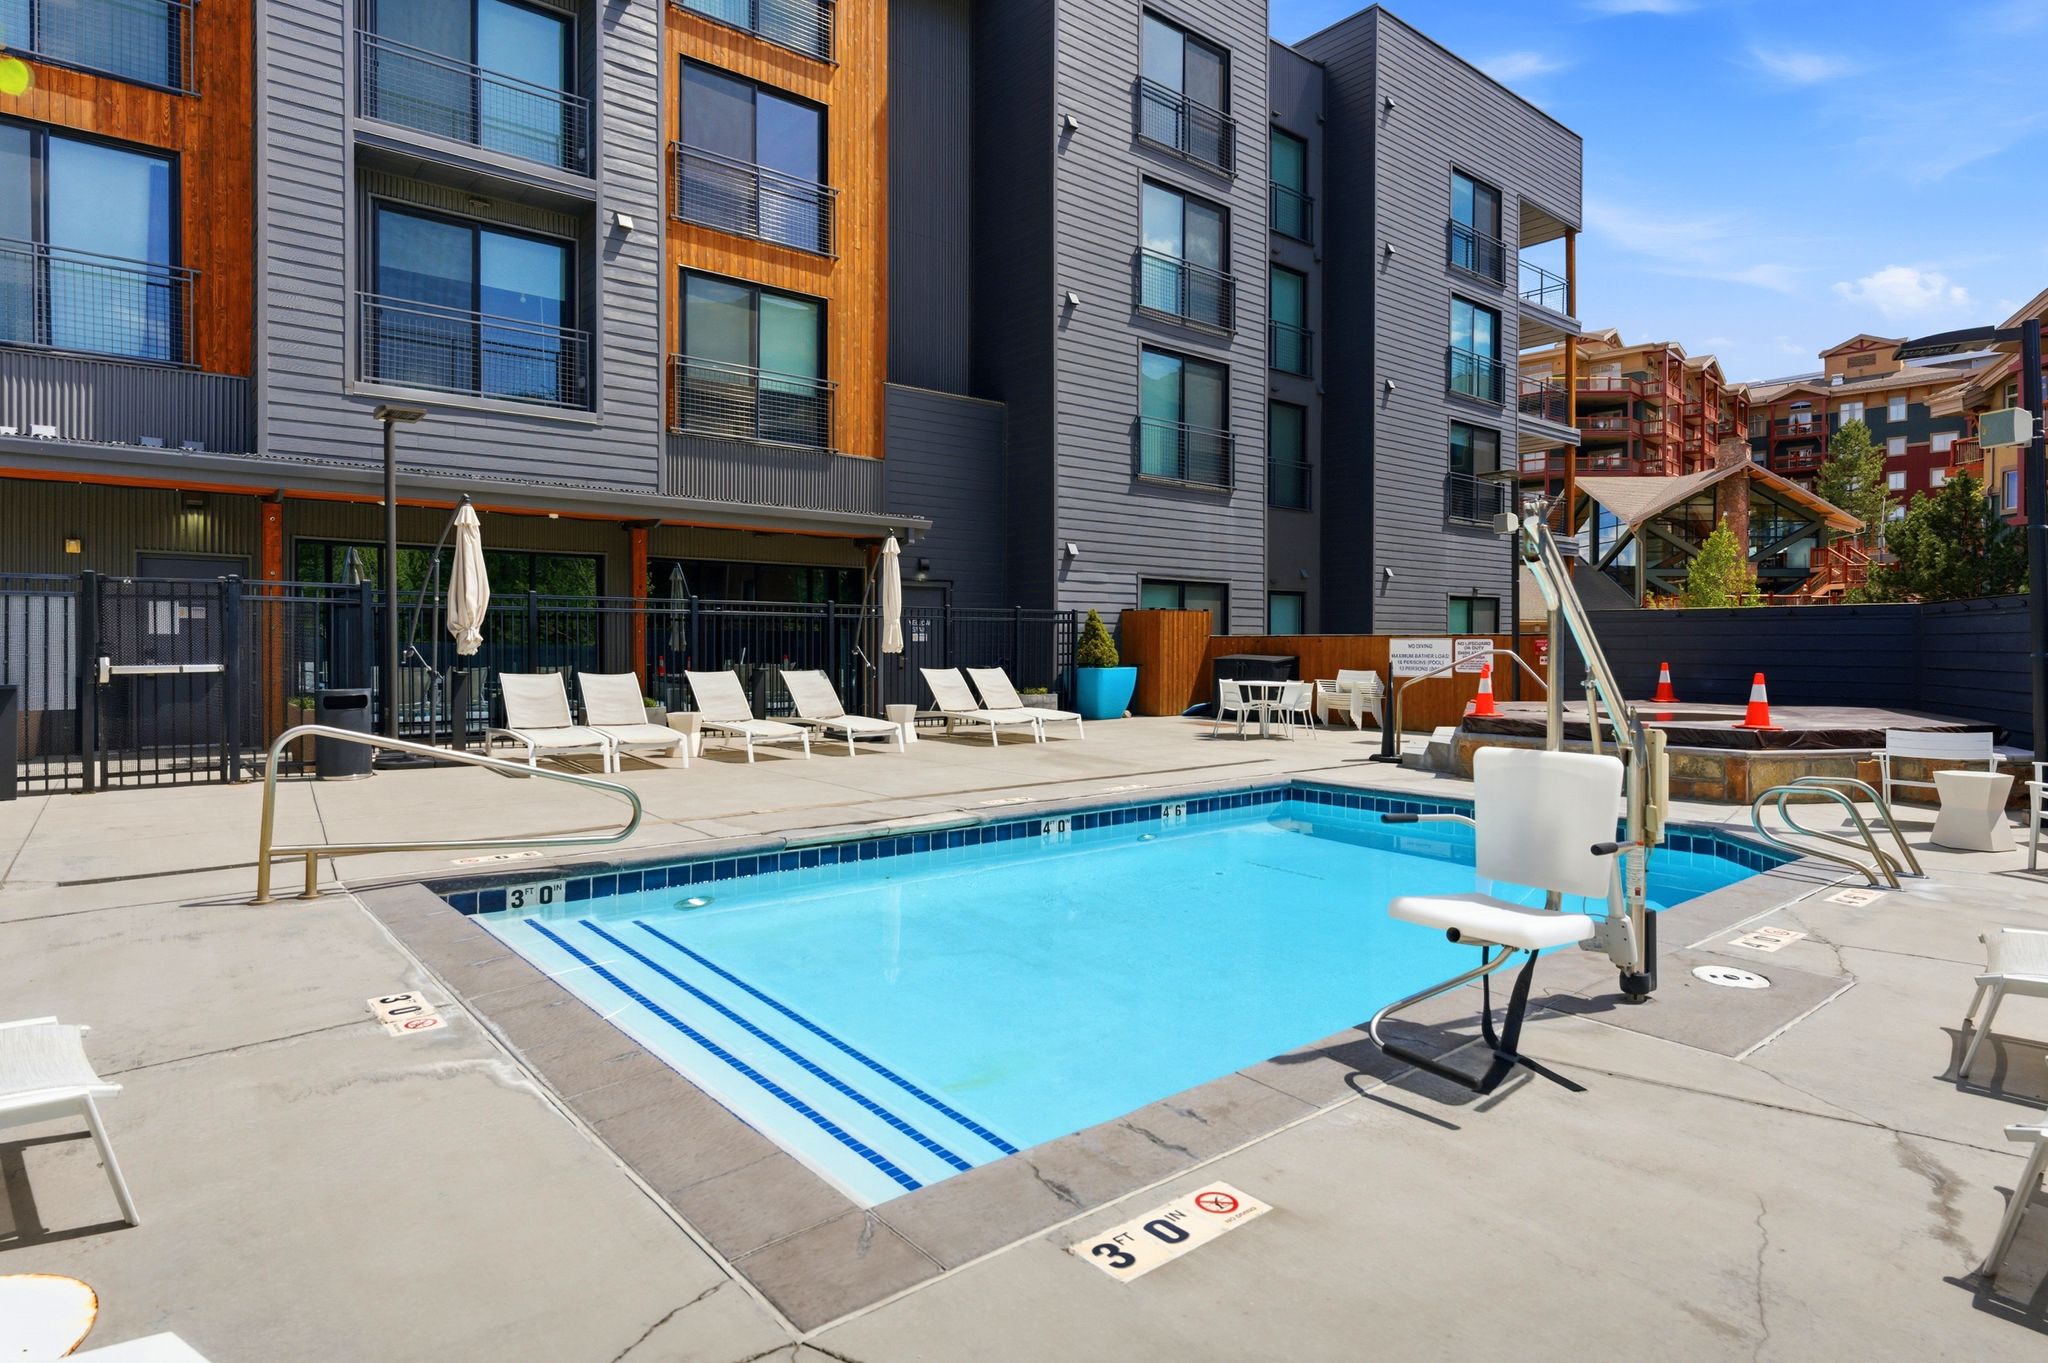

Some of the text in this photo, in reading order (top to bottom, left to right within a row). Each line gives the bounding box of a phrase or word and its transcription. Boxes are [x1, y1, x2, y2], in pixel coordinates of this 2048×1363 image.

[1163, 805, 1169, 817] 4
[1175, 804, 1181, 816] 6
[1043, 821, 1050, 834] 4
[1058, 819, 1065, 832] 0
[511, 889, 524, 908] 3
[525, 887, 534, 895] FT
[539, 885, 553, 904] 0
[379, 994, 412, 1004] 3
[388, 1005, 422, 1015] 0
[1092, 1209, 1190, 1268] 3 FT 0 IN
